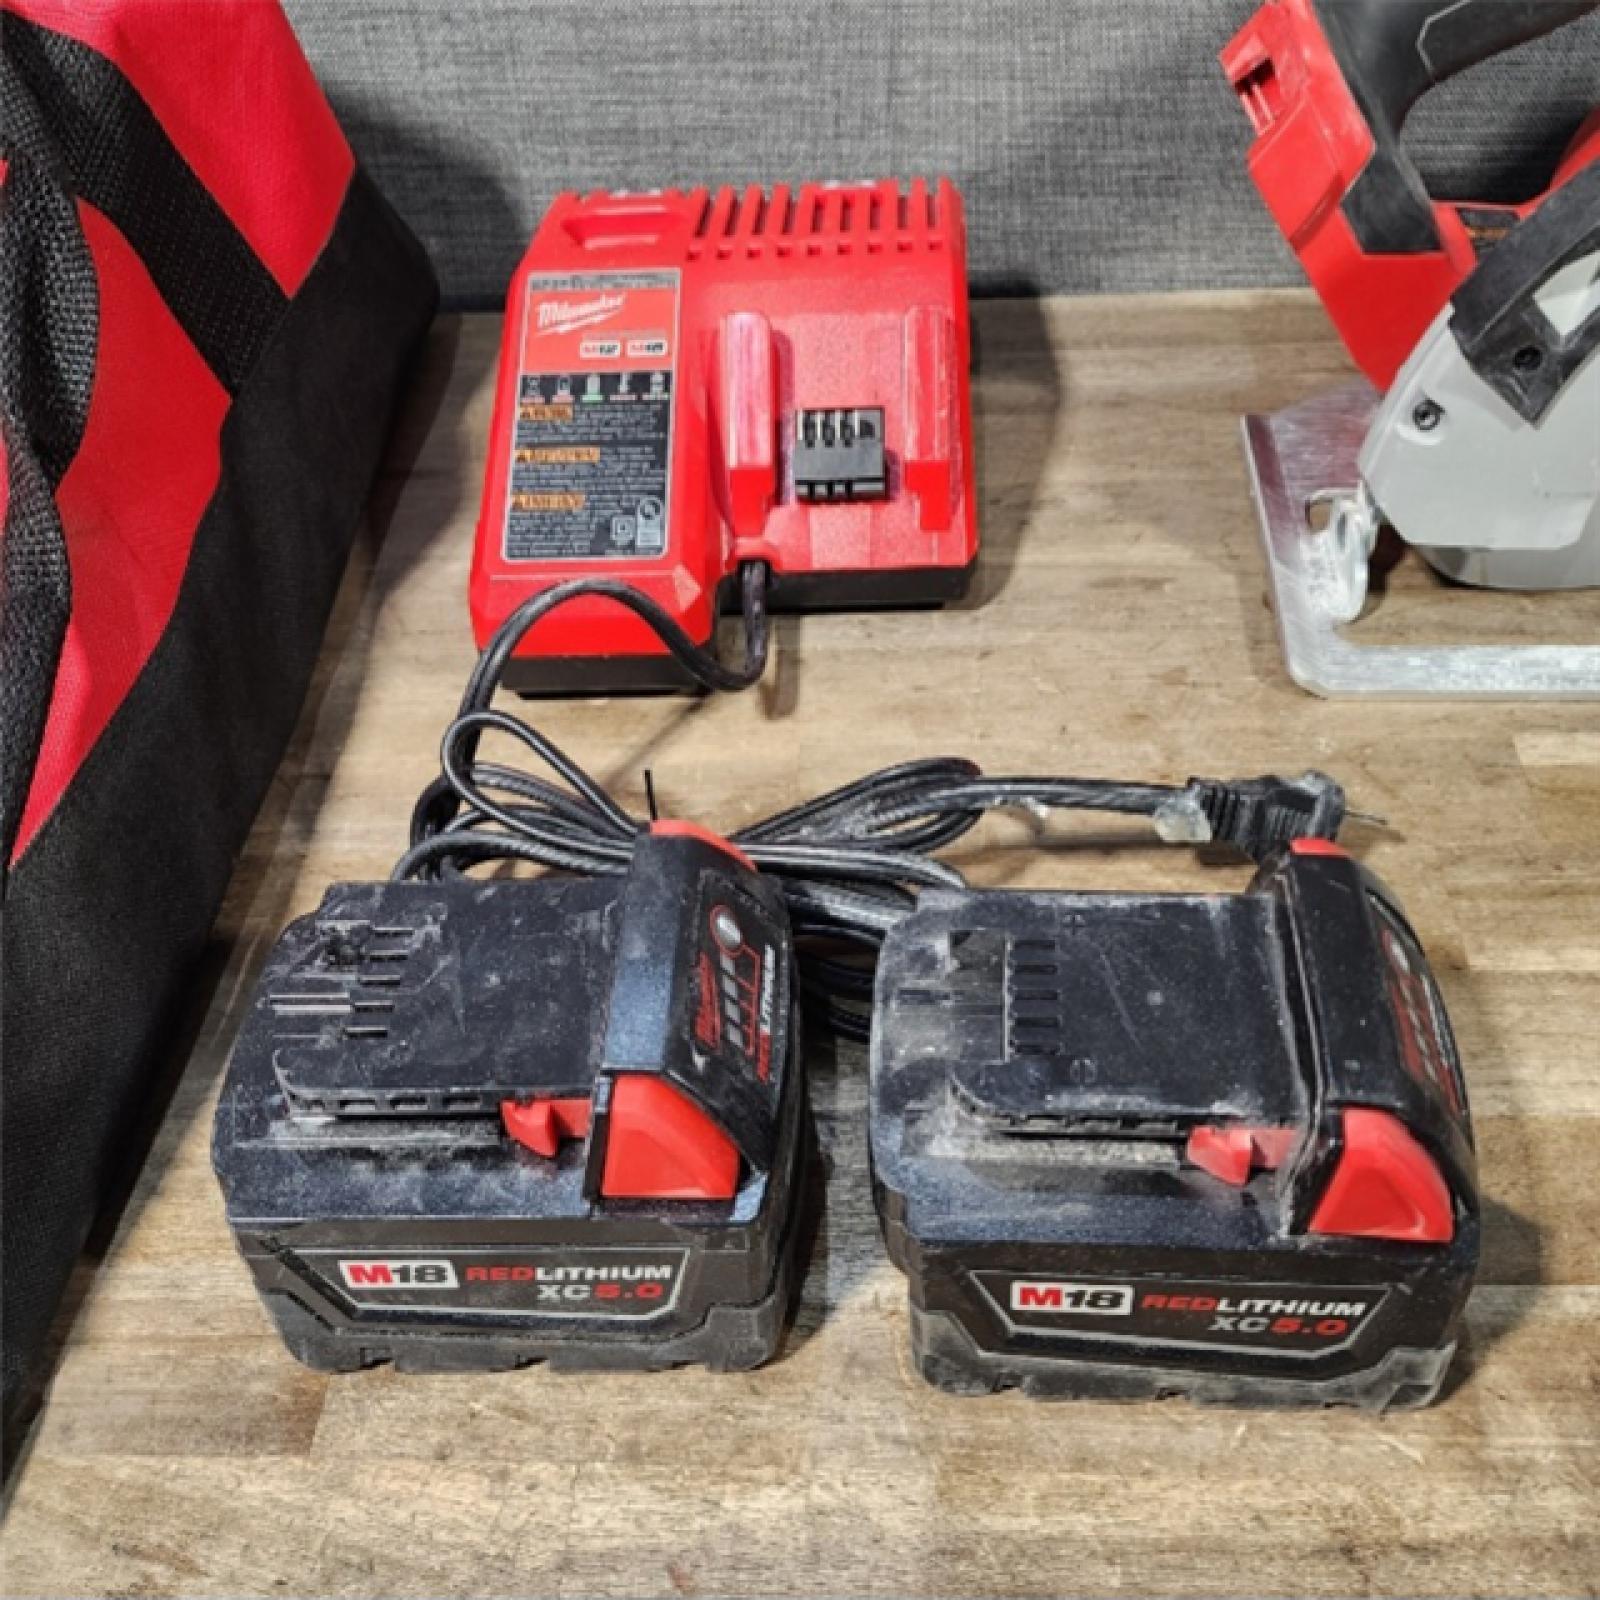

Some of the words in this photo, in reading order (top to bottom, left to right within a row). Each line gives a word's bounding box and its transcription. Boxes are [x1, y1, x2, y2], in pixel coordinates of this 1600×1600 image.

[346, 1263, 450, 1286] M18
[465, 1264, 673, 1282] REDLITHIUM
[1018, 1287, 1126, 1311] M18
[1140, 1294, 1366, 1317] REDLITHIUM
